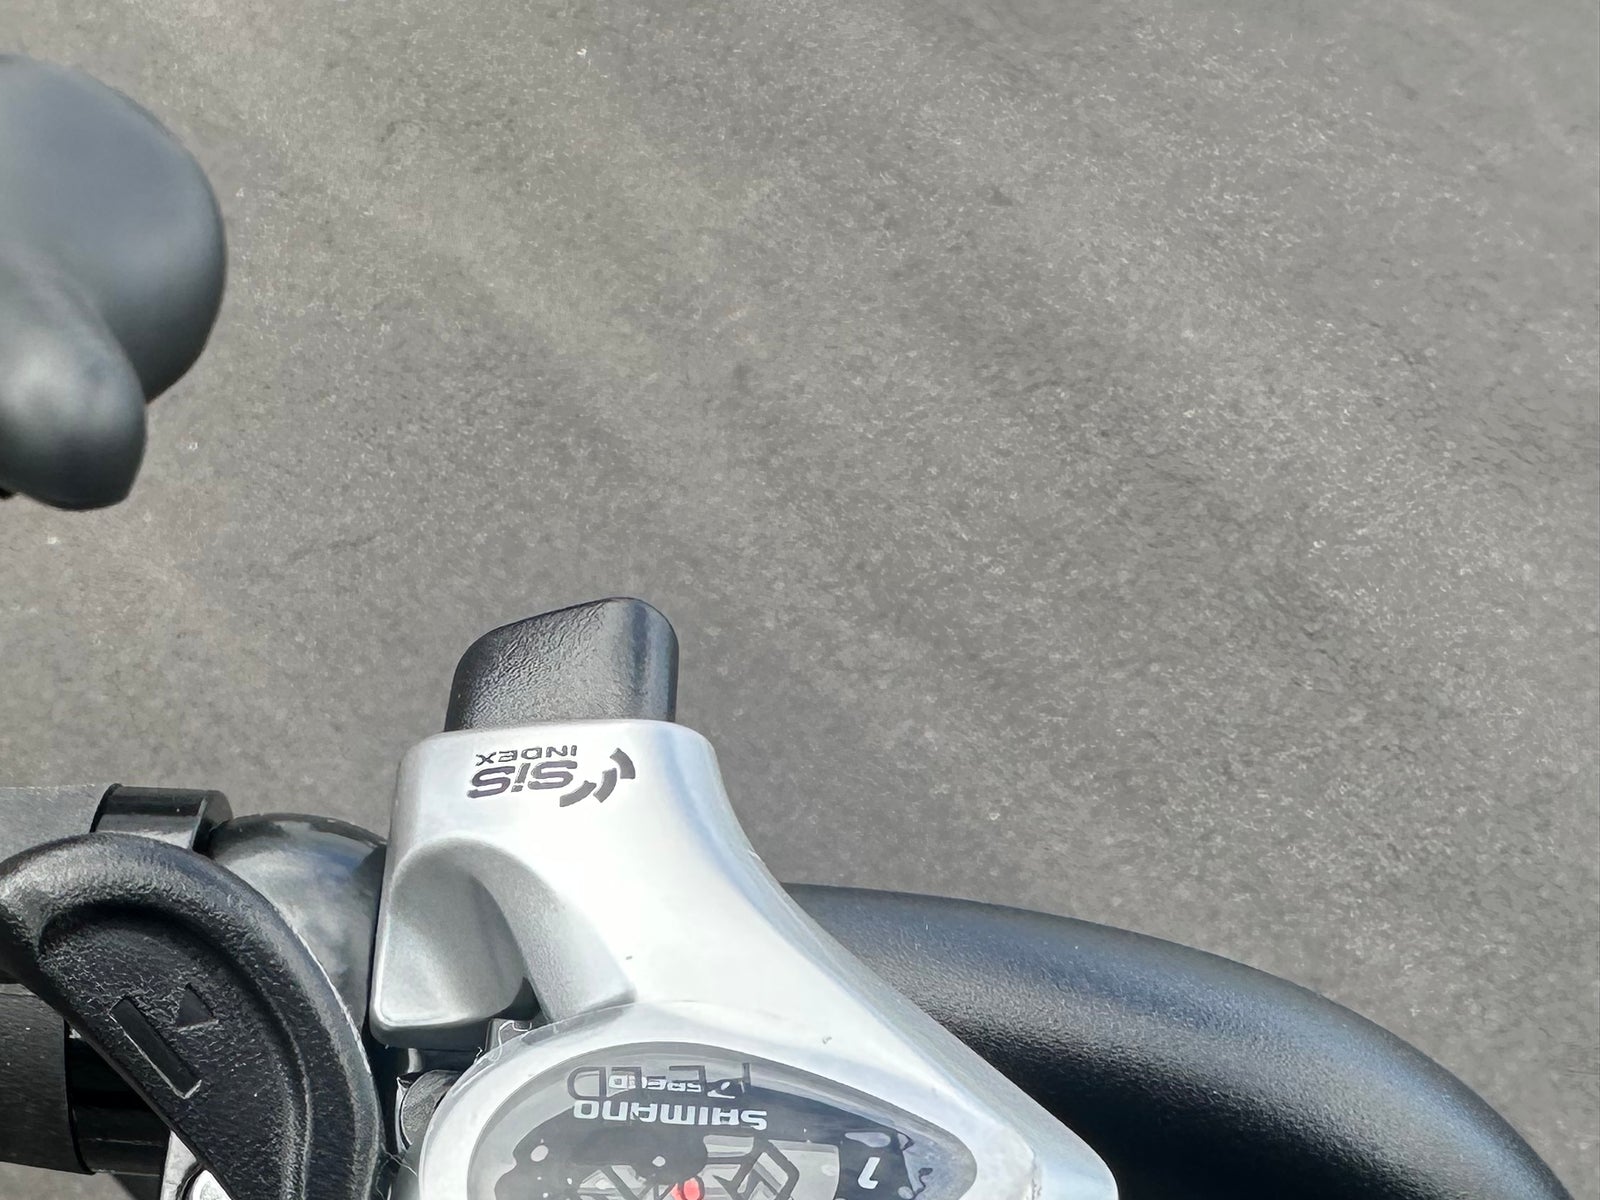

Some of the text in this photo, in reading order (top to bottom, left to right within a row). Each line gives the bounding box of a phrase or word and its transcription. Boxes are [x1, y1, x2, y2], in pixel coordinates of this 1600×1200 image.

[475, 745, 577, 767] INDEX
[573, 1100, 768, 1131] SHIMANO
[857, 1157, 880, 1190] 1
